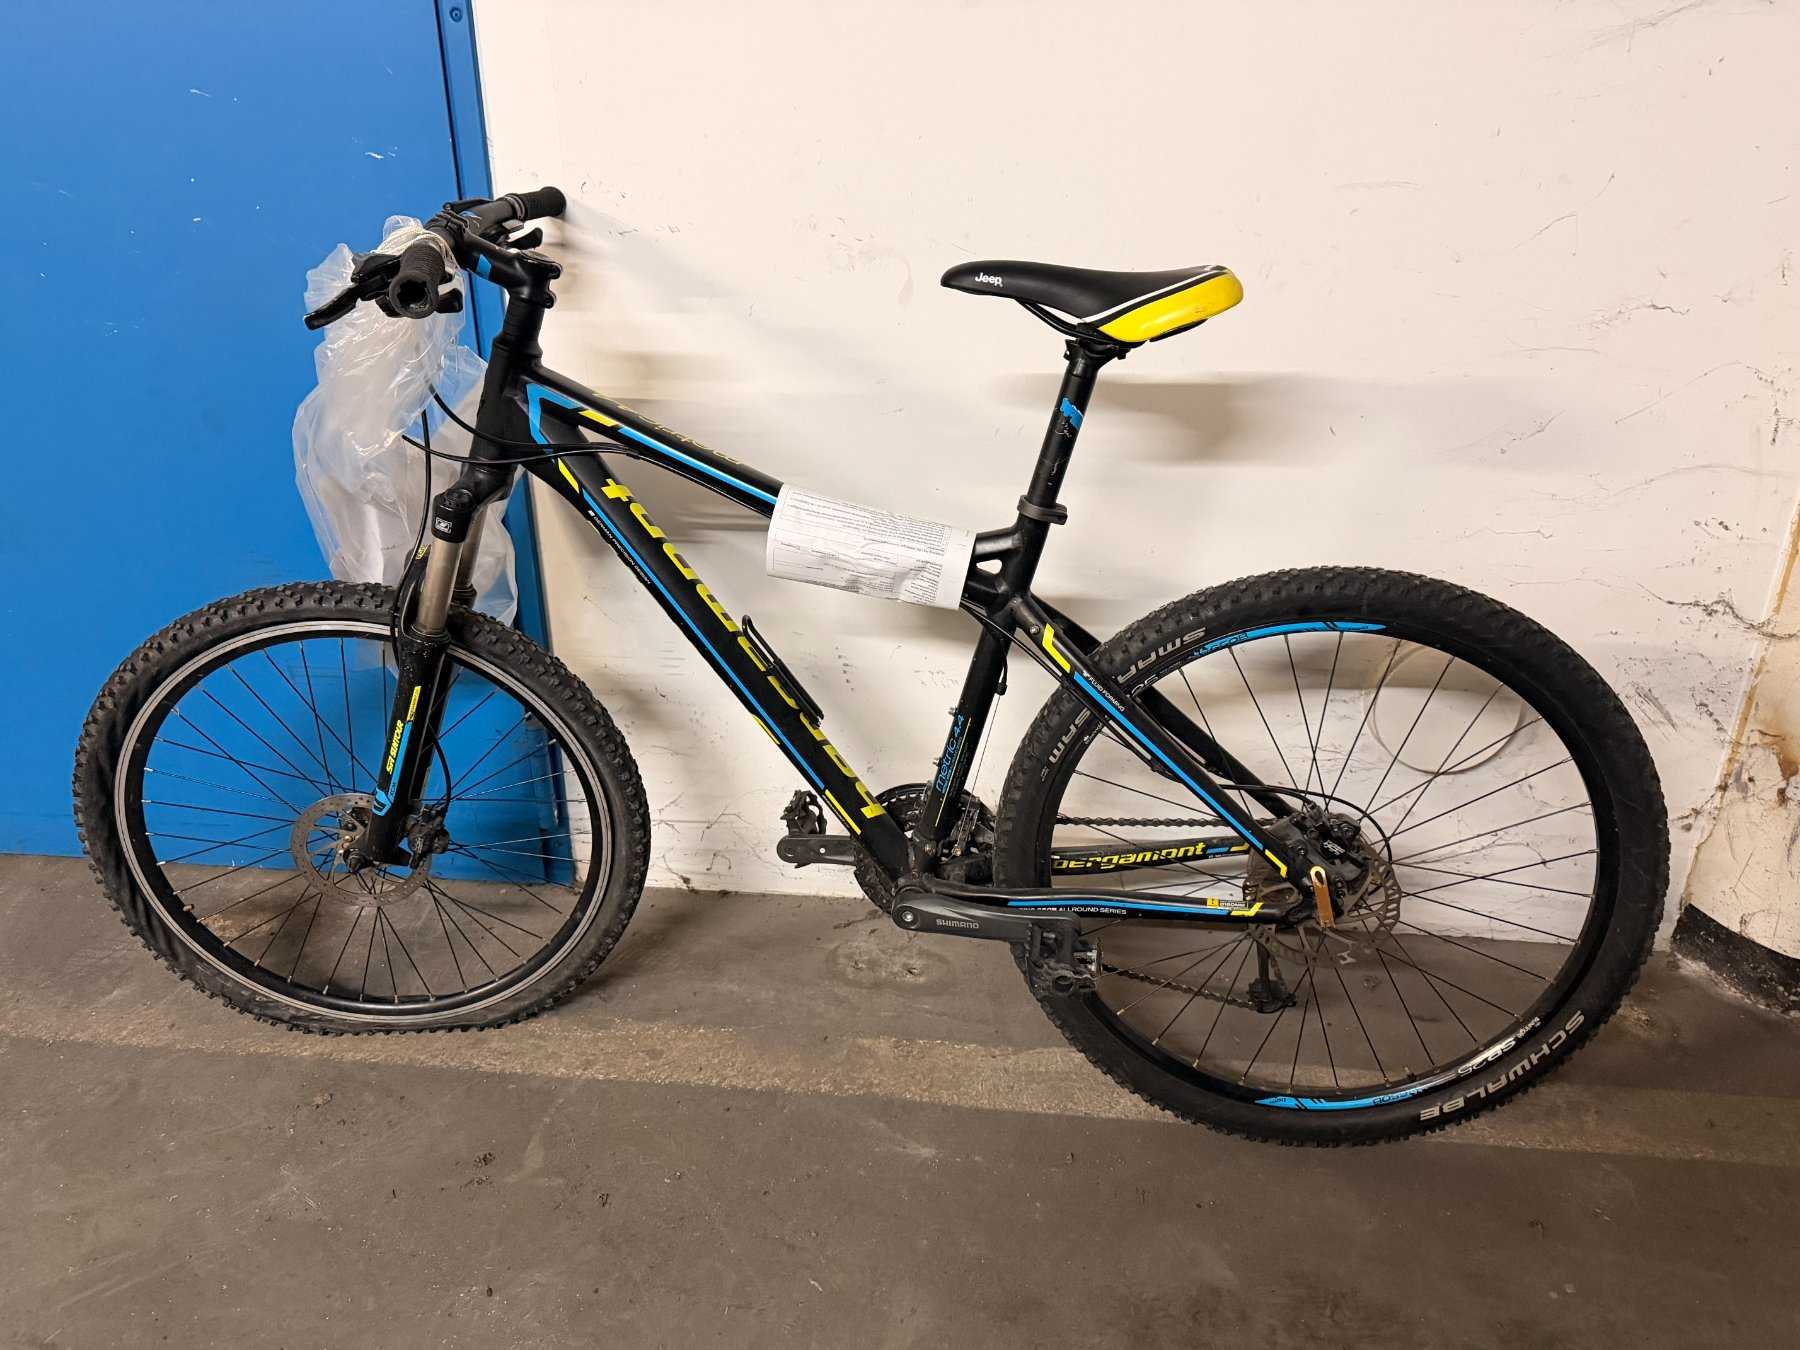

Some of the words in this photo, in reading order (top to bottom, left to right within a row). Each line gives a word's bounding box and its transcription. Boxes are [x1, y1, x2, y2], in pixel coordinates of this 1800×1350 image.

[975, 272, 1002, 286] Jeep
[1115, 626, 1207, 685] SMAR
[1099, 907, 1127, 915] SERIES
[936, 918, 980, 929] SHIMANO
[1419, 1010, 1585, 1121] SCHWALBE
